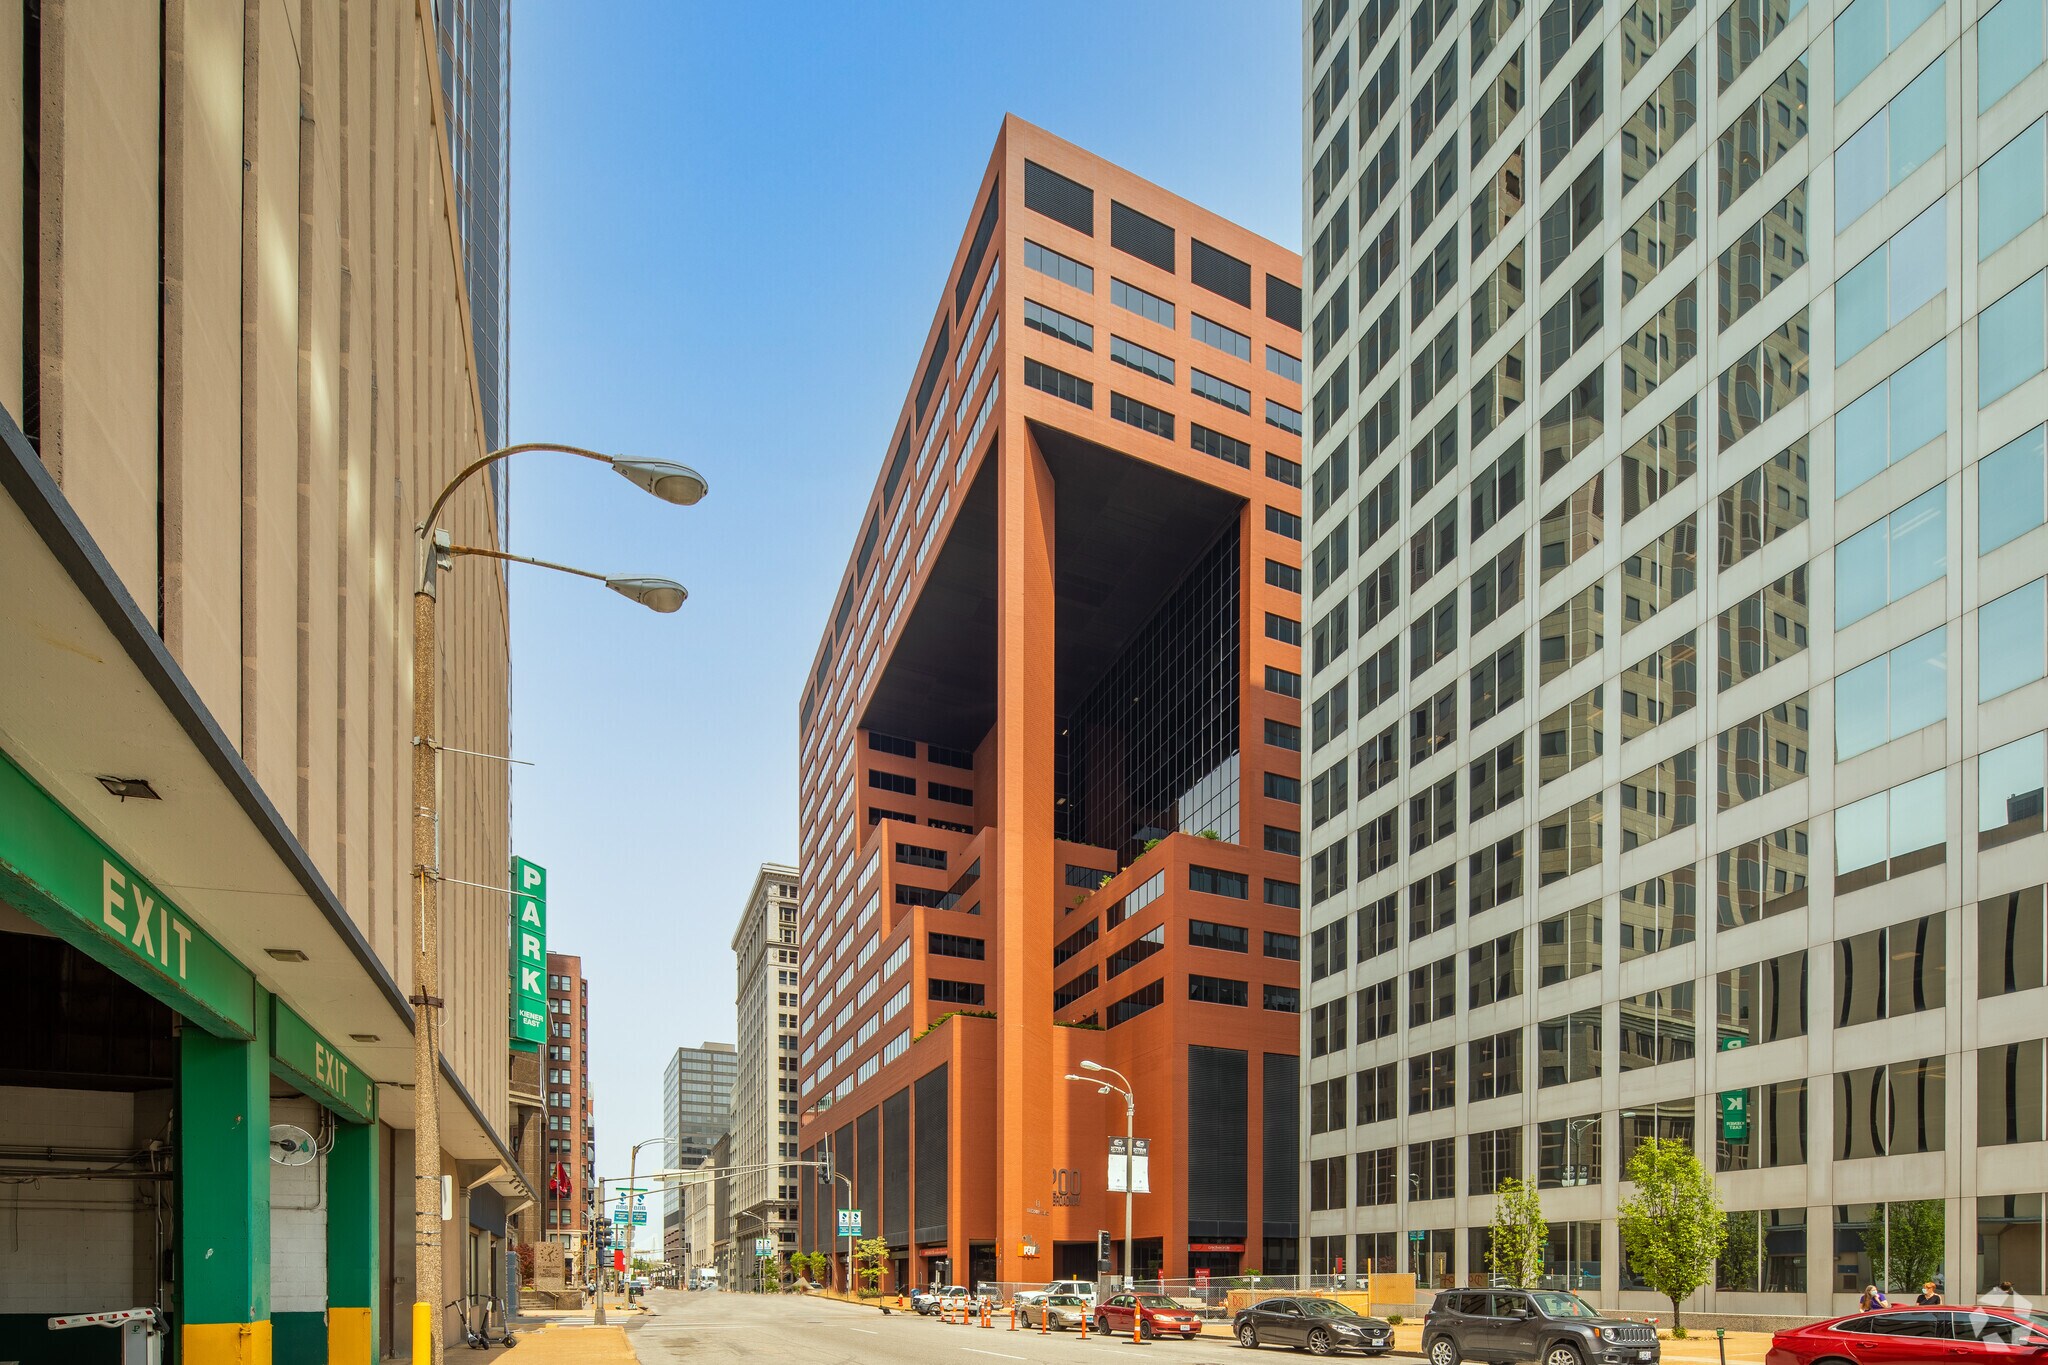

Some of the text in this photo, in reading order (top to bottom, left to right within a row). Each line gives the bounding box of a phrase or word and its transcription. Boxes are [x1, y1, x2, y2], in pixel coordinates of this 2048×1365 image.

[103, 859, 192, 980] EXIT
[522, 865, 541, 995] PARK
[520, 1010, 544, 1023] KIENER
[523, 1018, 541, 1029] EAST
[316, 1041, 348, 1097] EXIT
